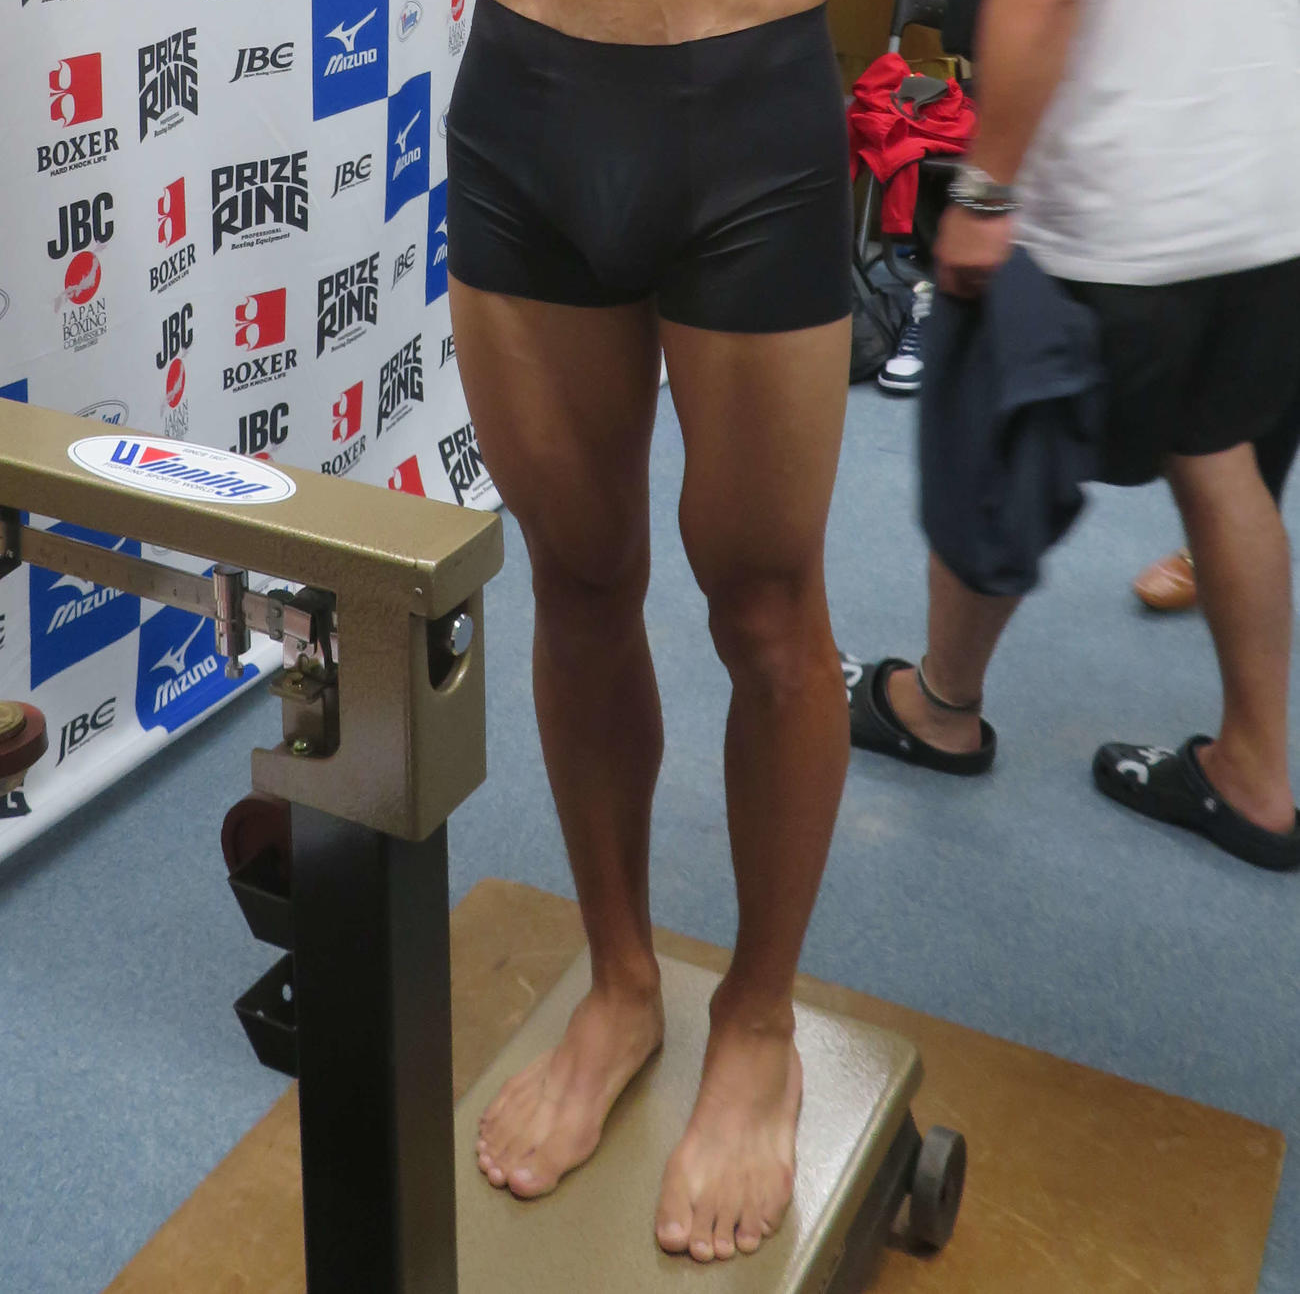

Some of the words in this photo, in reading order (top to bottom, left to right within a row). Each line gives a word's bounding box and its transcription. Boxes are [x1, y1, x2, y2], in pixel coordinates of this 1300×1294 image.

[138, 27, 198, 93] PRIZE
[138, 62, 199, 144] RING
[37, 127, 120, 173] BOXER
[50, 167, 68, 178] HARD
[68, 159, 93, 172] KNOCK
[93, 155, 107, 165] LIFE
[212, 150, 308, 211] PRIZE
[47, 192, 114, 260] JBC
[212, 184, 308, 256] RING
[231, 241, 255, 251] Boxing
[255, 232, 290, 245] Equipment
[241, 227, 281, 240] PROFESSIONAL
[149, 243, 196, 292] BOXER
[318, 251, 380, 319] PRIZE
[63, 298, 105, 327] JAPAN
[63, 312, 106, 341] BOXING
[156, 303, 193, 370] JBC
[316, 285, 378, 359] RING
[223, 349, 297, 391] BOXER
[232, 383, 249, 394] HARD
[249, 376, 273, 388] KNOCK
[273, 372, 287, 381] LIFE
[379, 333, 422, 401] PRIZE
[229, 402, 290, 456] JBC
[376, 366, 424, 440] RING
[320, 434, 367, 475] BOXER
[438, 422, 477, 475] PRI
[450, 442, 486, 507] RIN
[104, 461, 145, 475] FIGHTING
[145, 471, 181, 485] SPORTS
[181, 481, 216, 494] WORLD
[46, 586, 125, 635] MIZUN
